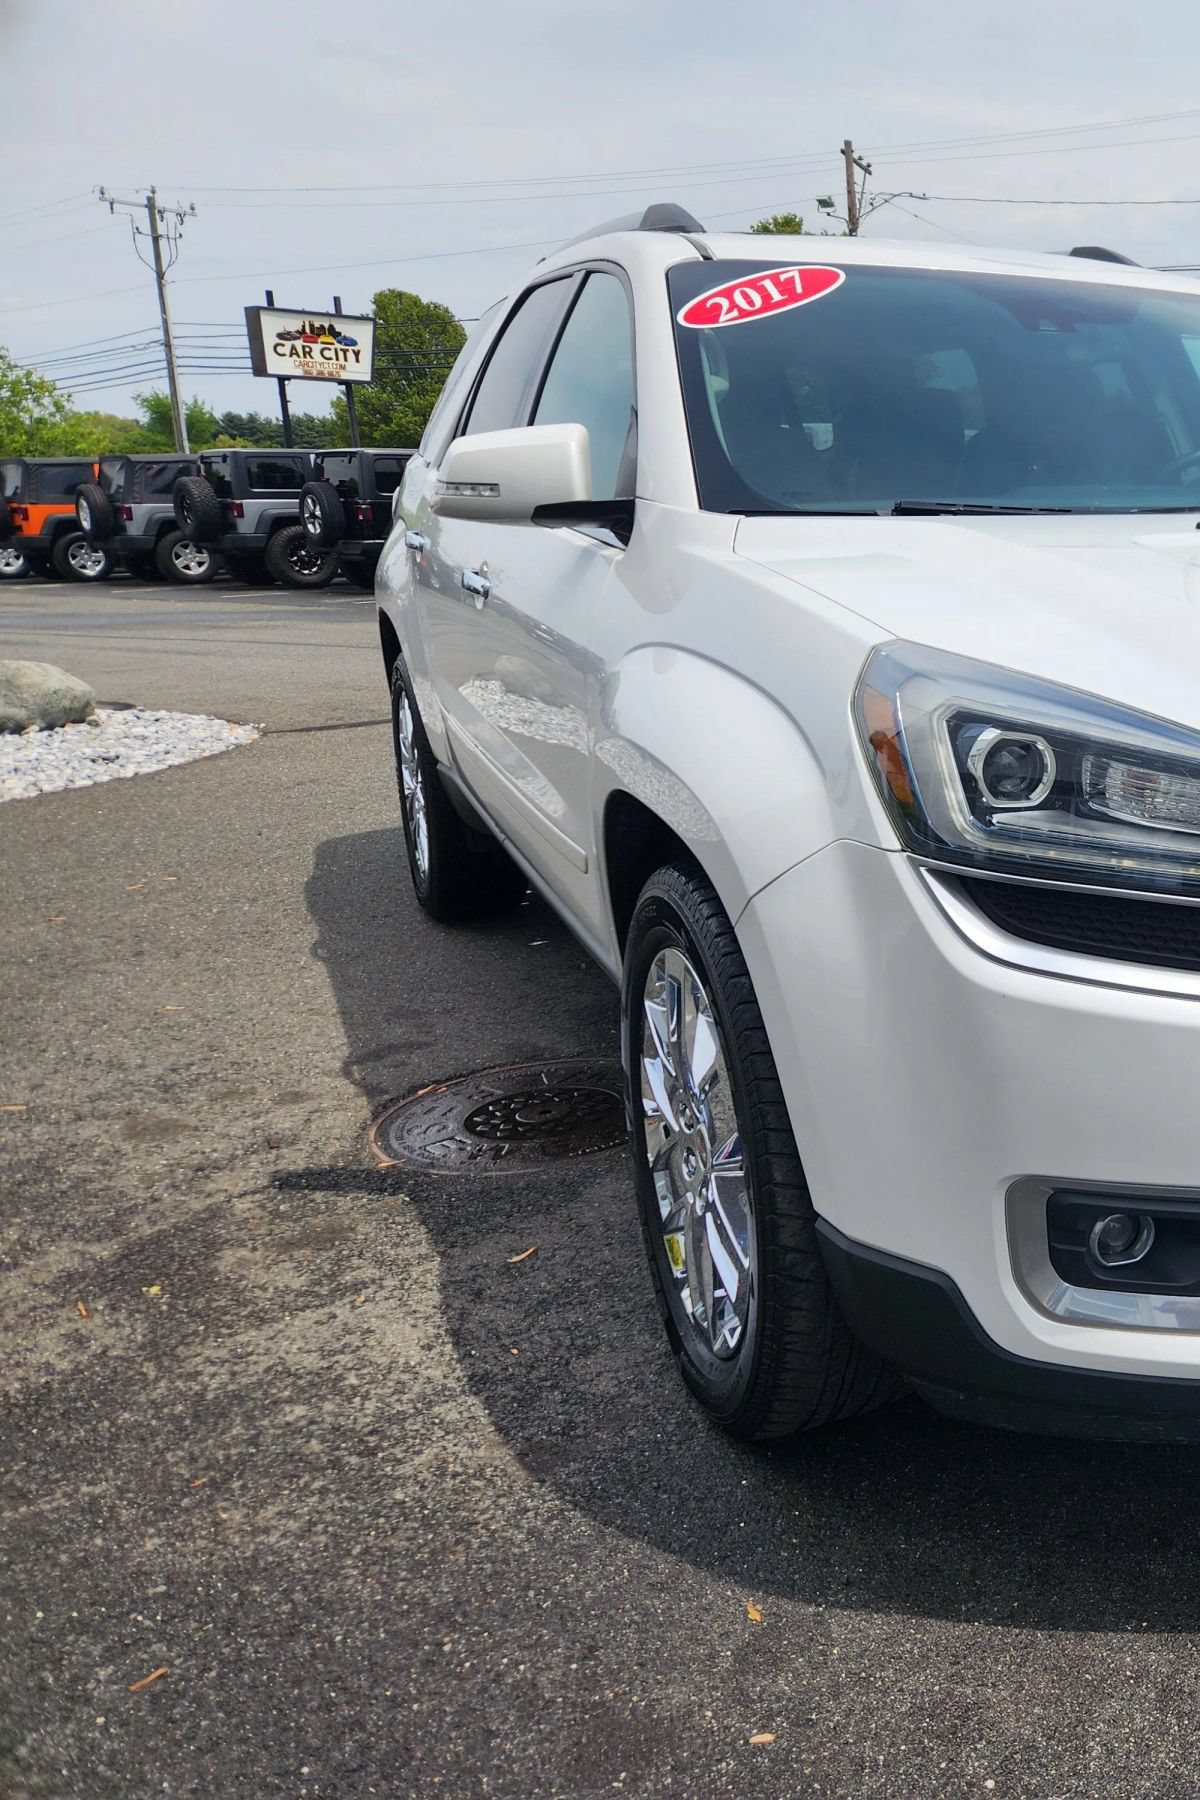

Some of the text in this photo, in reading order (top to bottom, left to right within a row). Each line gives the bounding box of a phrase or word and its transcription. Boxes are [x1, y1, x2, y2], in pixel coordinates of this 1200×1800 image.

[706, 270, 803, 323] 2017
[273, 342, 361, 363] CAR CITY
